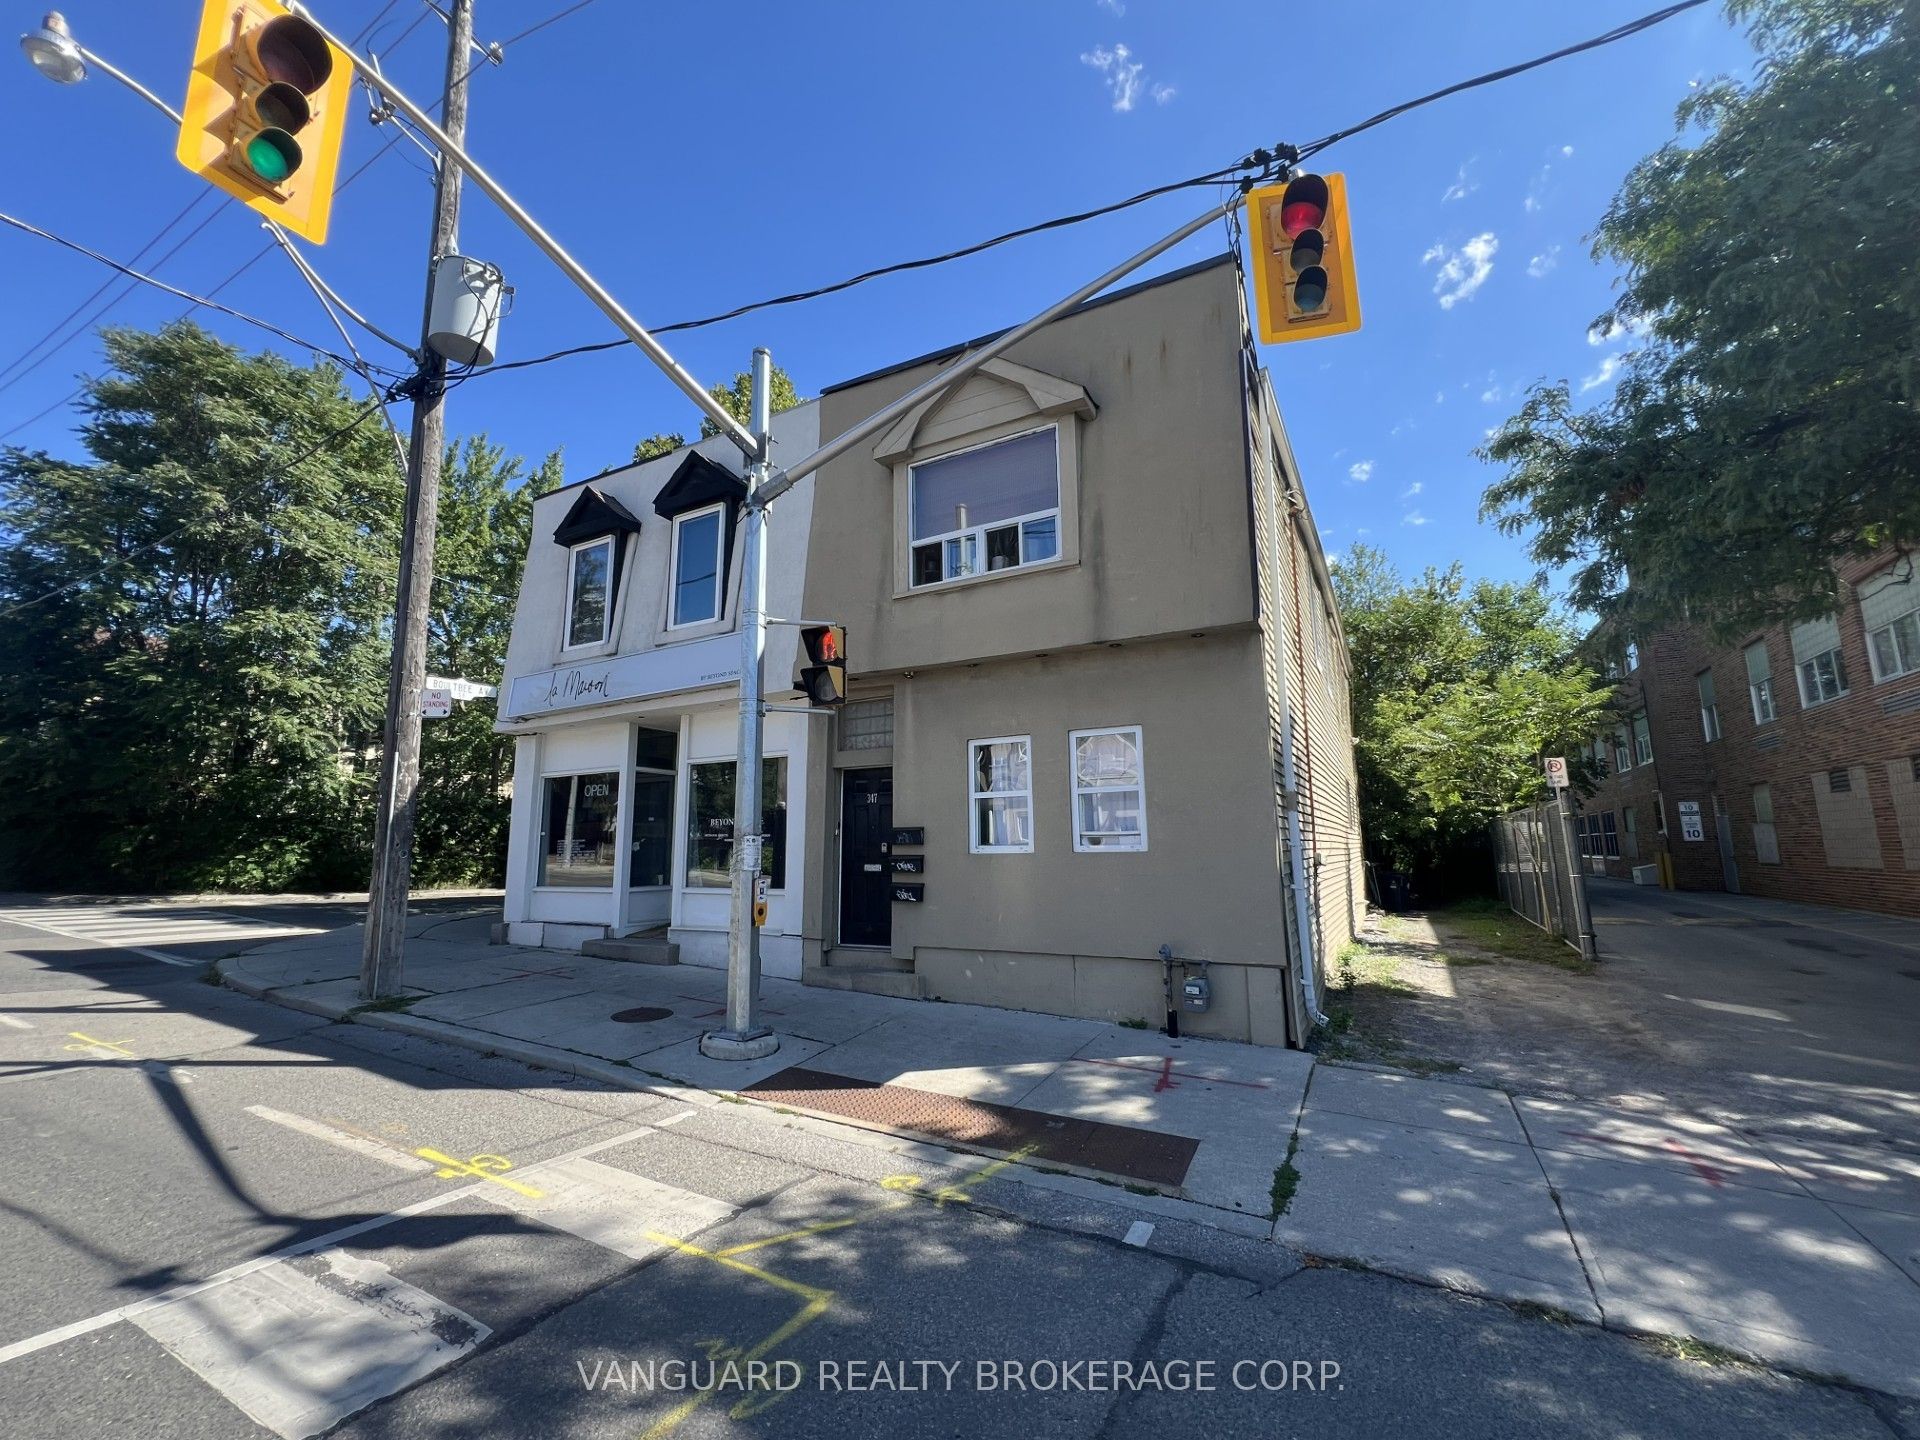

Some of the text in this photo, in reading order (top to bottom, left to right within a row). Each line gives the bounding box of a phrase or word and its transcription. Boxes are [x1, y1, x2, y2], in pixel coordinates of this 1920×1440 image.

[422, 700, 448, 708] STANDING
[584, 784, 609, 797] OPEN
[866, 793, 878, 803] 347
[710, 818, 735, 826] BEYON
[1685, 829, 1701, 838] 10
